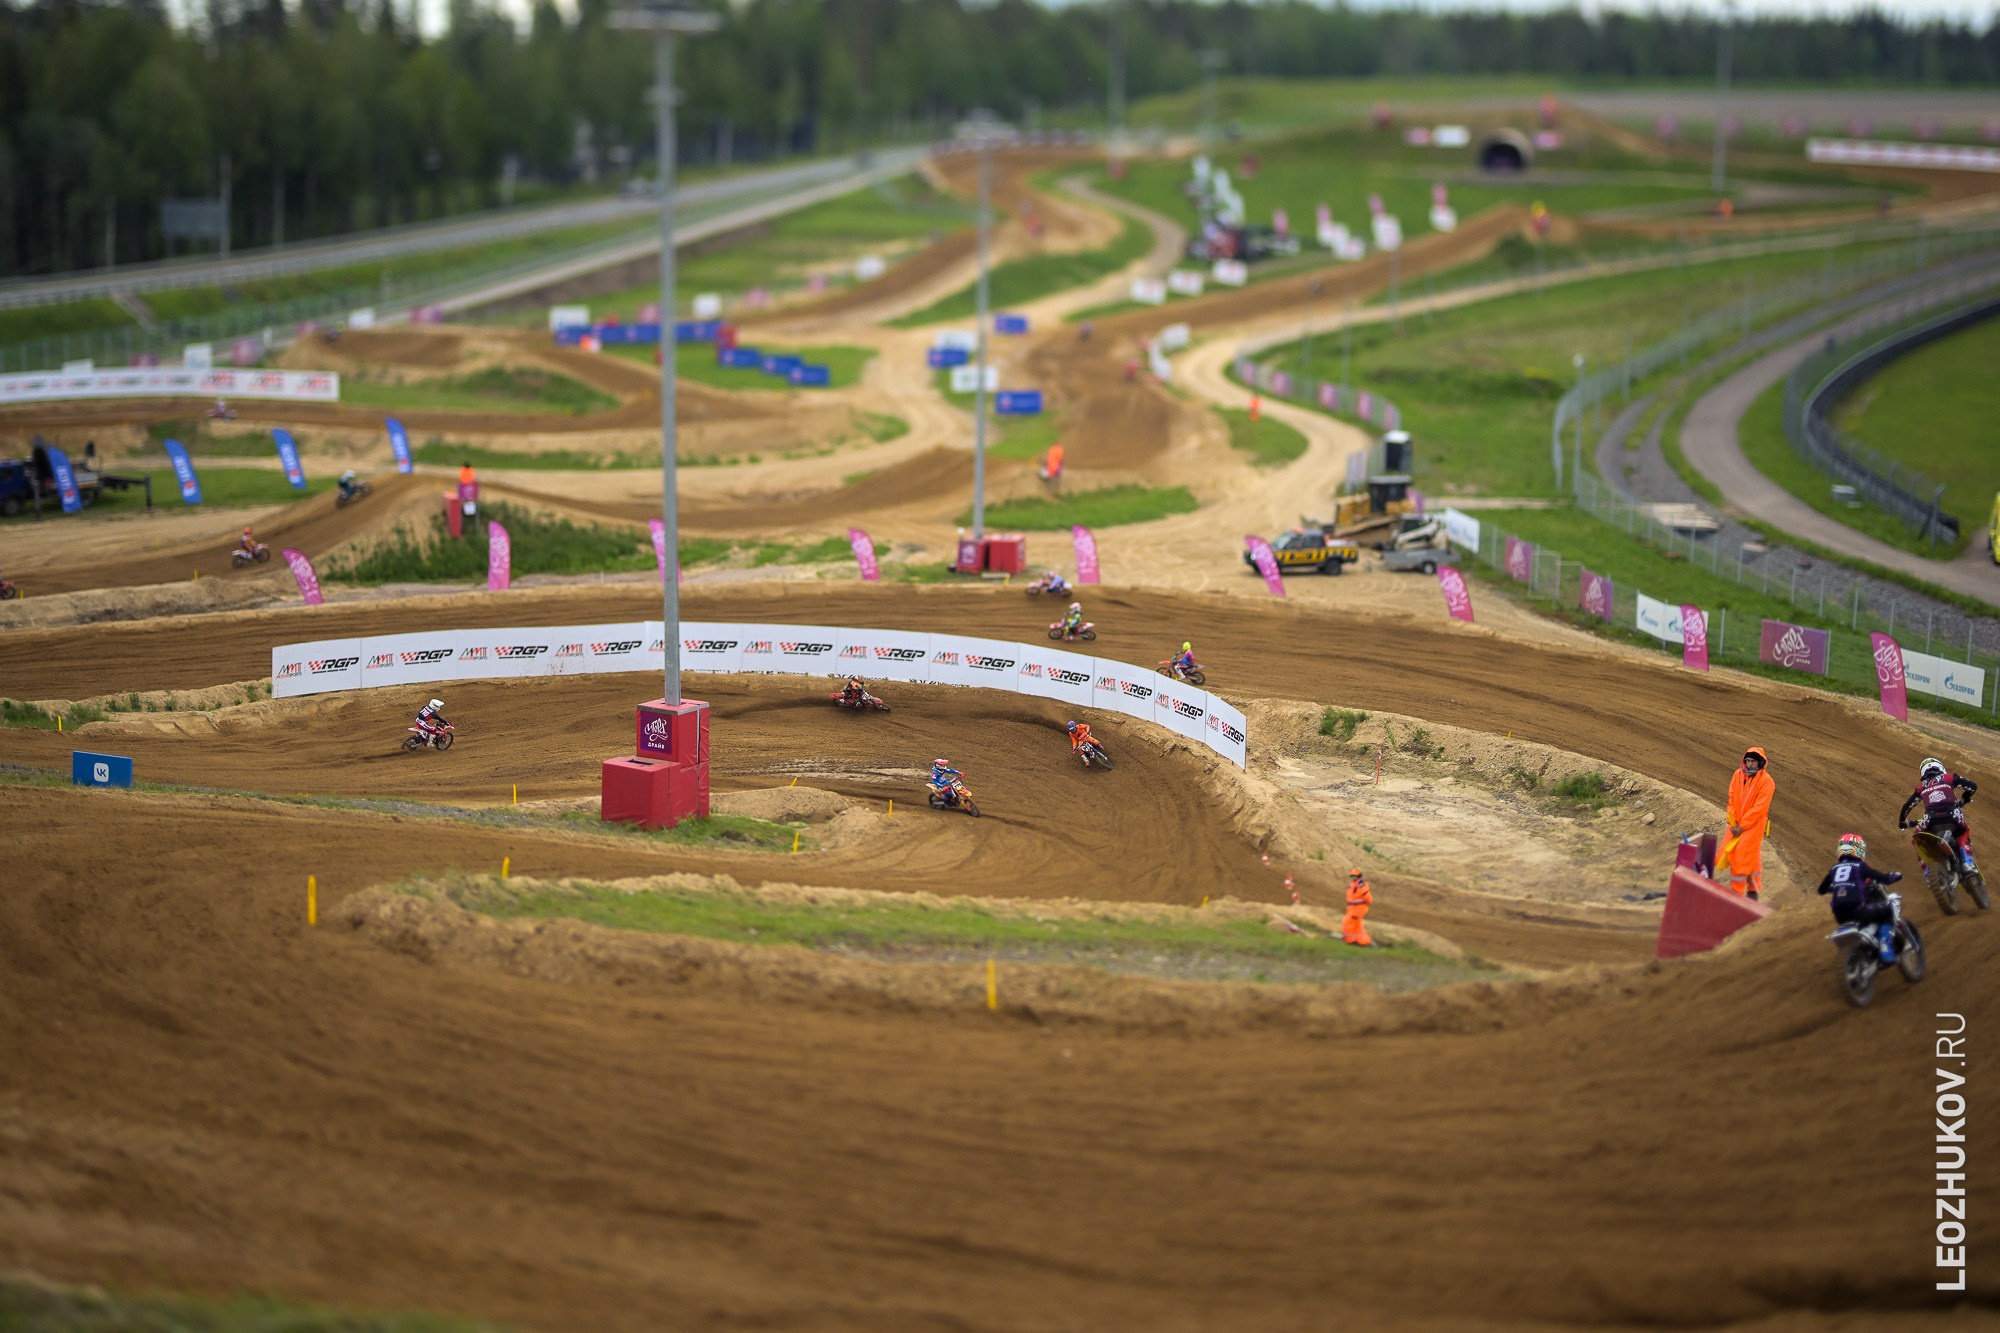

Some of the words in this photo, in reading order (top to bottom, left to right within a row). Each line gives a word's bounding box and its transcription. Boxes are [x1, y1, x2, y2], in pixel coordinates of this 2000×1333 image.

[509, 646, 548, 656] RGP
[605, 640, 642, 652] RGP
[699, 640, 738, 650] RGP
[794, 642, 832, 652] RGP
[414, 648, 454, 660] RGP
[888, 648, 926, 659] RGP
[321, 657, 360, 670] RGP
[979, 657, 1015, 669] RGP
[1059, 670, 1090, 682] RGP
[1130, 684, 1152, 696] RGP
[1181, 702, 1204, 717] RGP
[1228, 726, 1244, 742] RGP
[96, 768, 106, 778] VK
[1834, 866, 1852, 882] 8
